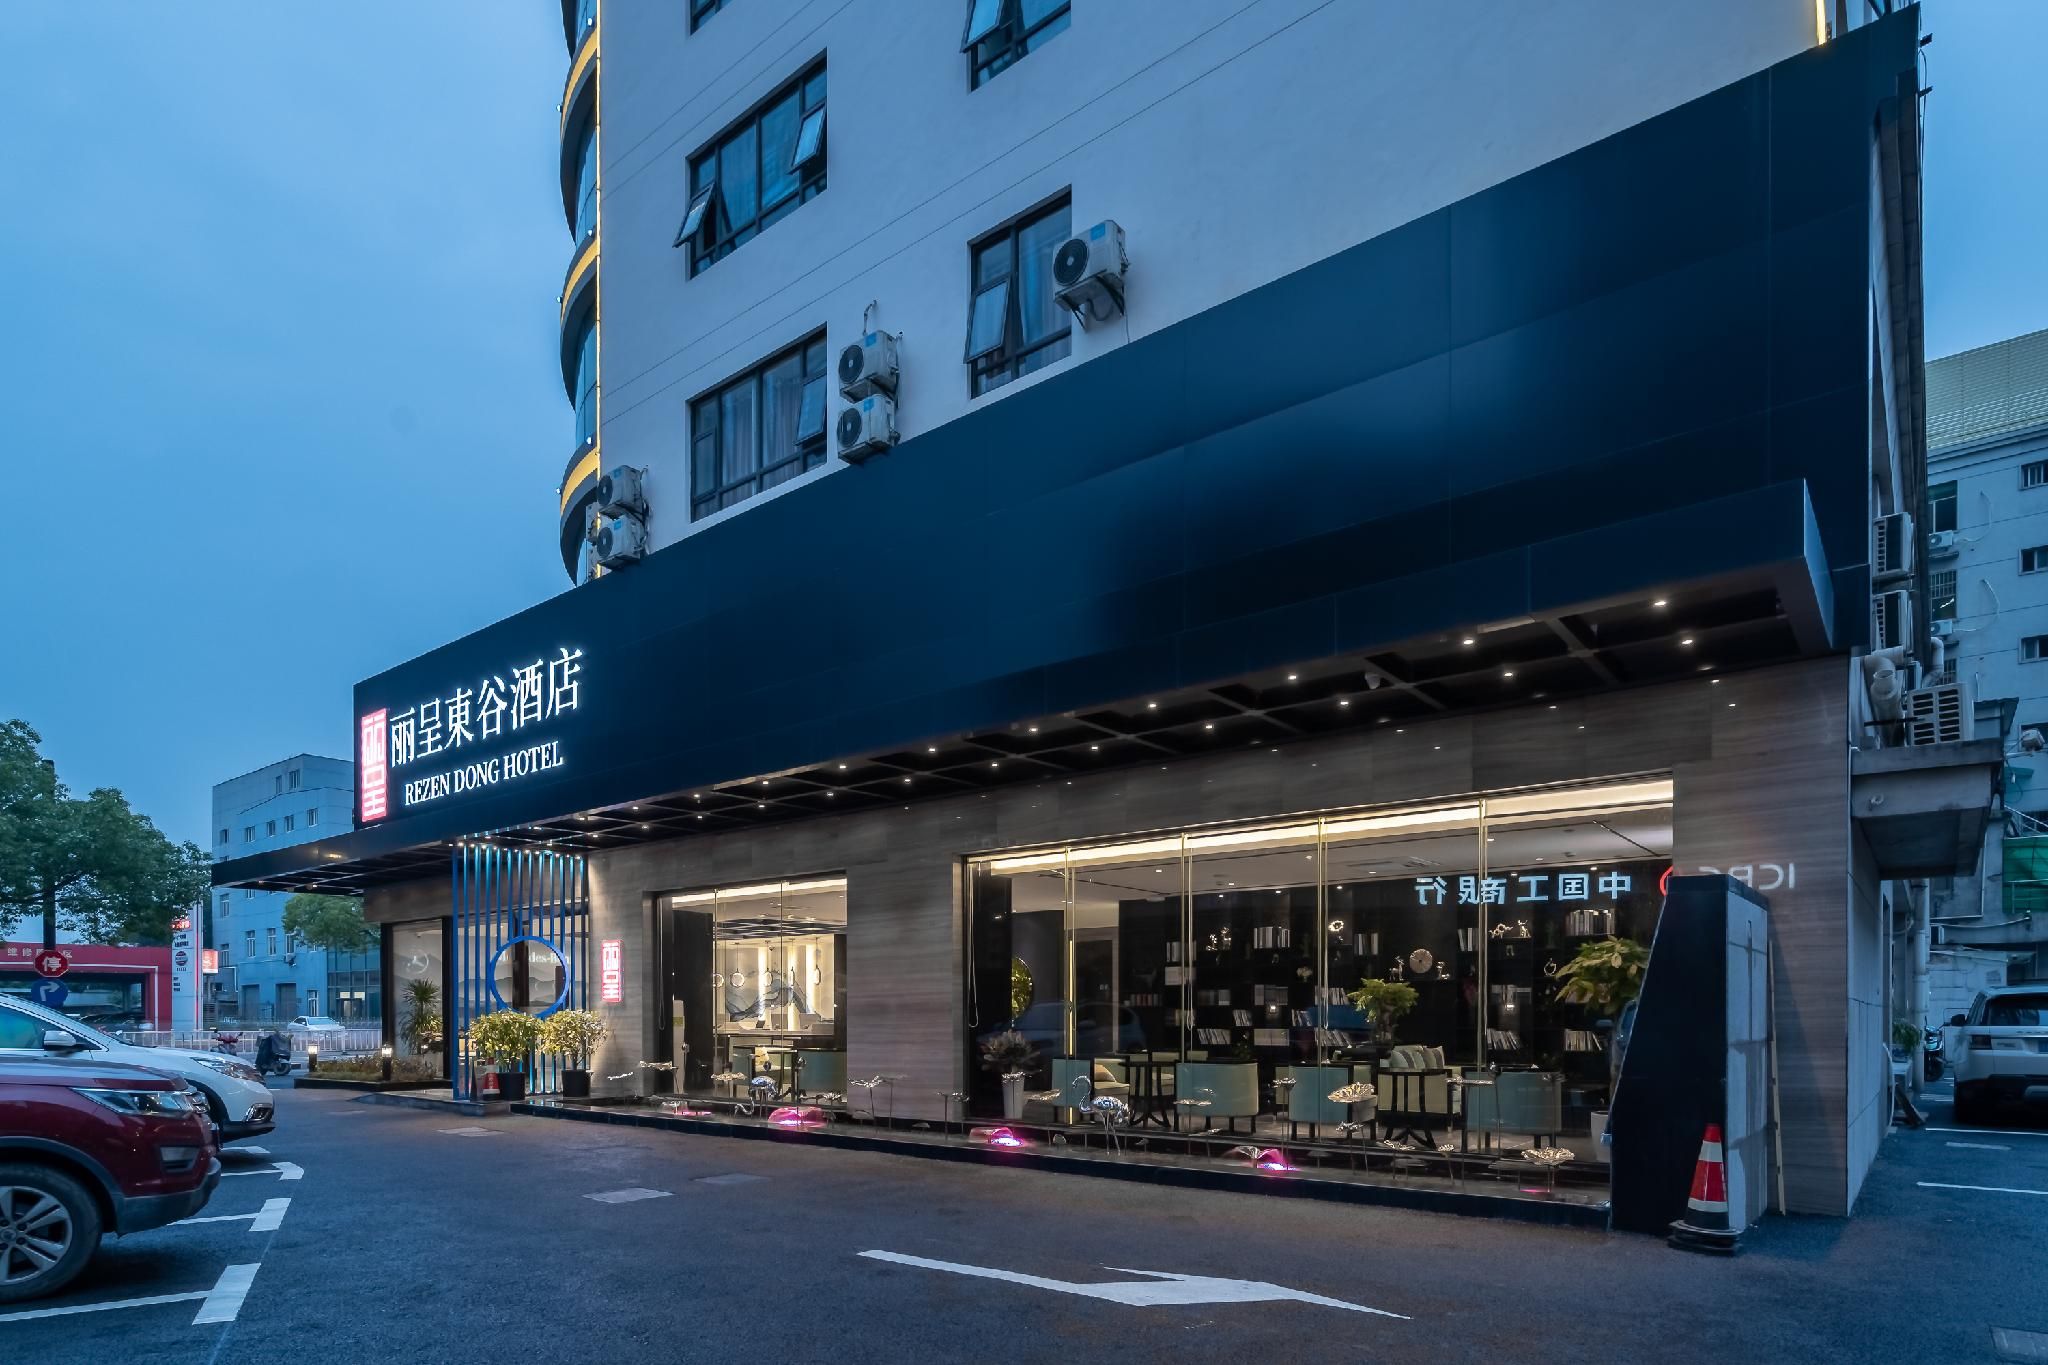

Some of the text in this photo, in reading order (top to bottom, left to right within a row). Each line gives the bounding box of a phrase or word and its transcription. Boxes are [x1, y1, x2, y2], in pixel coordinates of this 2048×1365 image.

[390, 648, 583, 768] 丽呈東谷酒店
[404, 741, 563, 806] REZEN DONG HOTEL
[42, 956, 62, 972] 停
